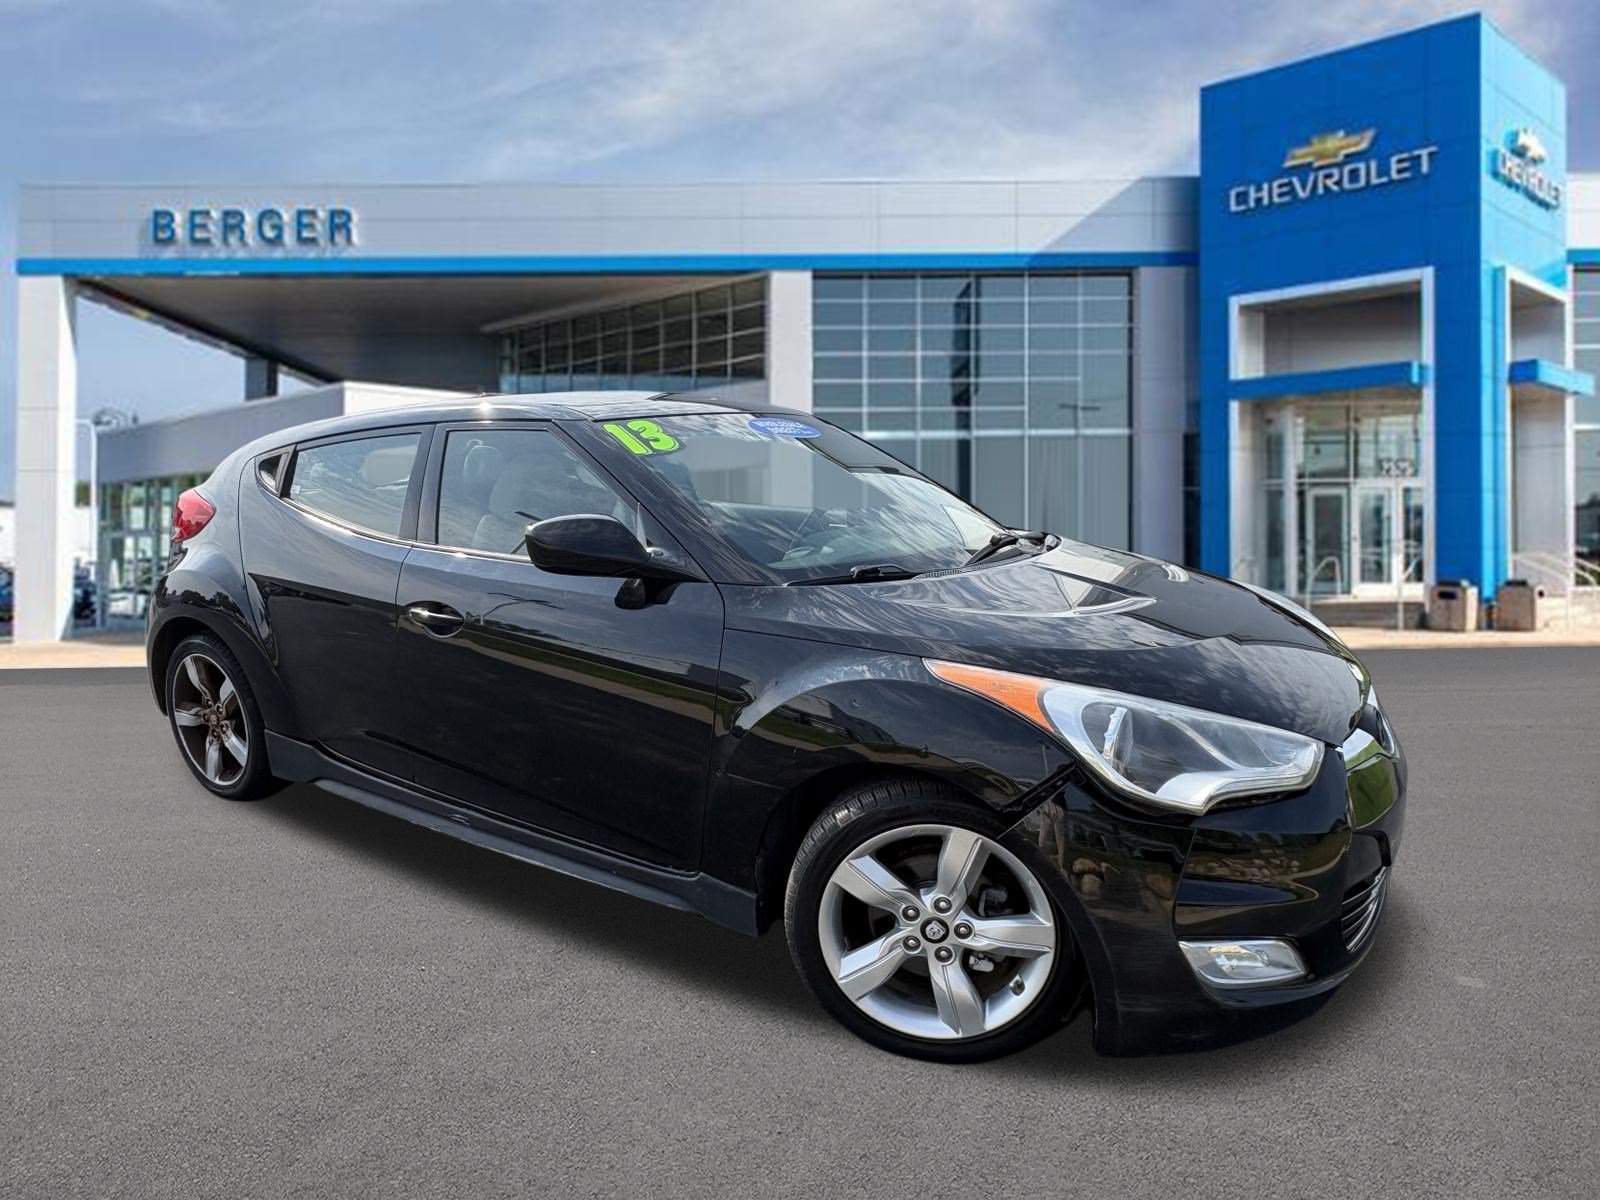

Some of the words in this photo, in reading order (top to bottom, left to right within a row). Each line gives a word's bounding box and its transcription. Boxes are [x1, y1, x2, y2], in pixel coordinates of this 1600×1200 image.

[1229, 146, 1438, 213] CHEVROLET
[152, 208, 357, 246] BERGER
[602, 419, 681, 456] 13
